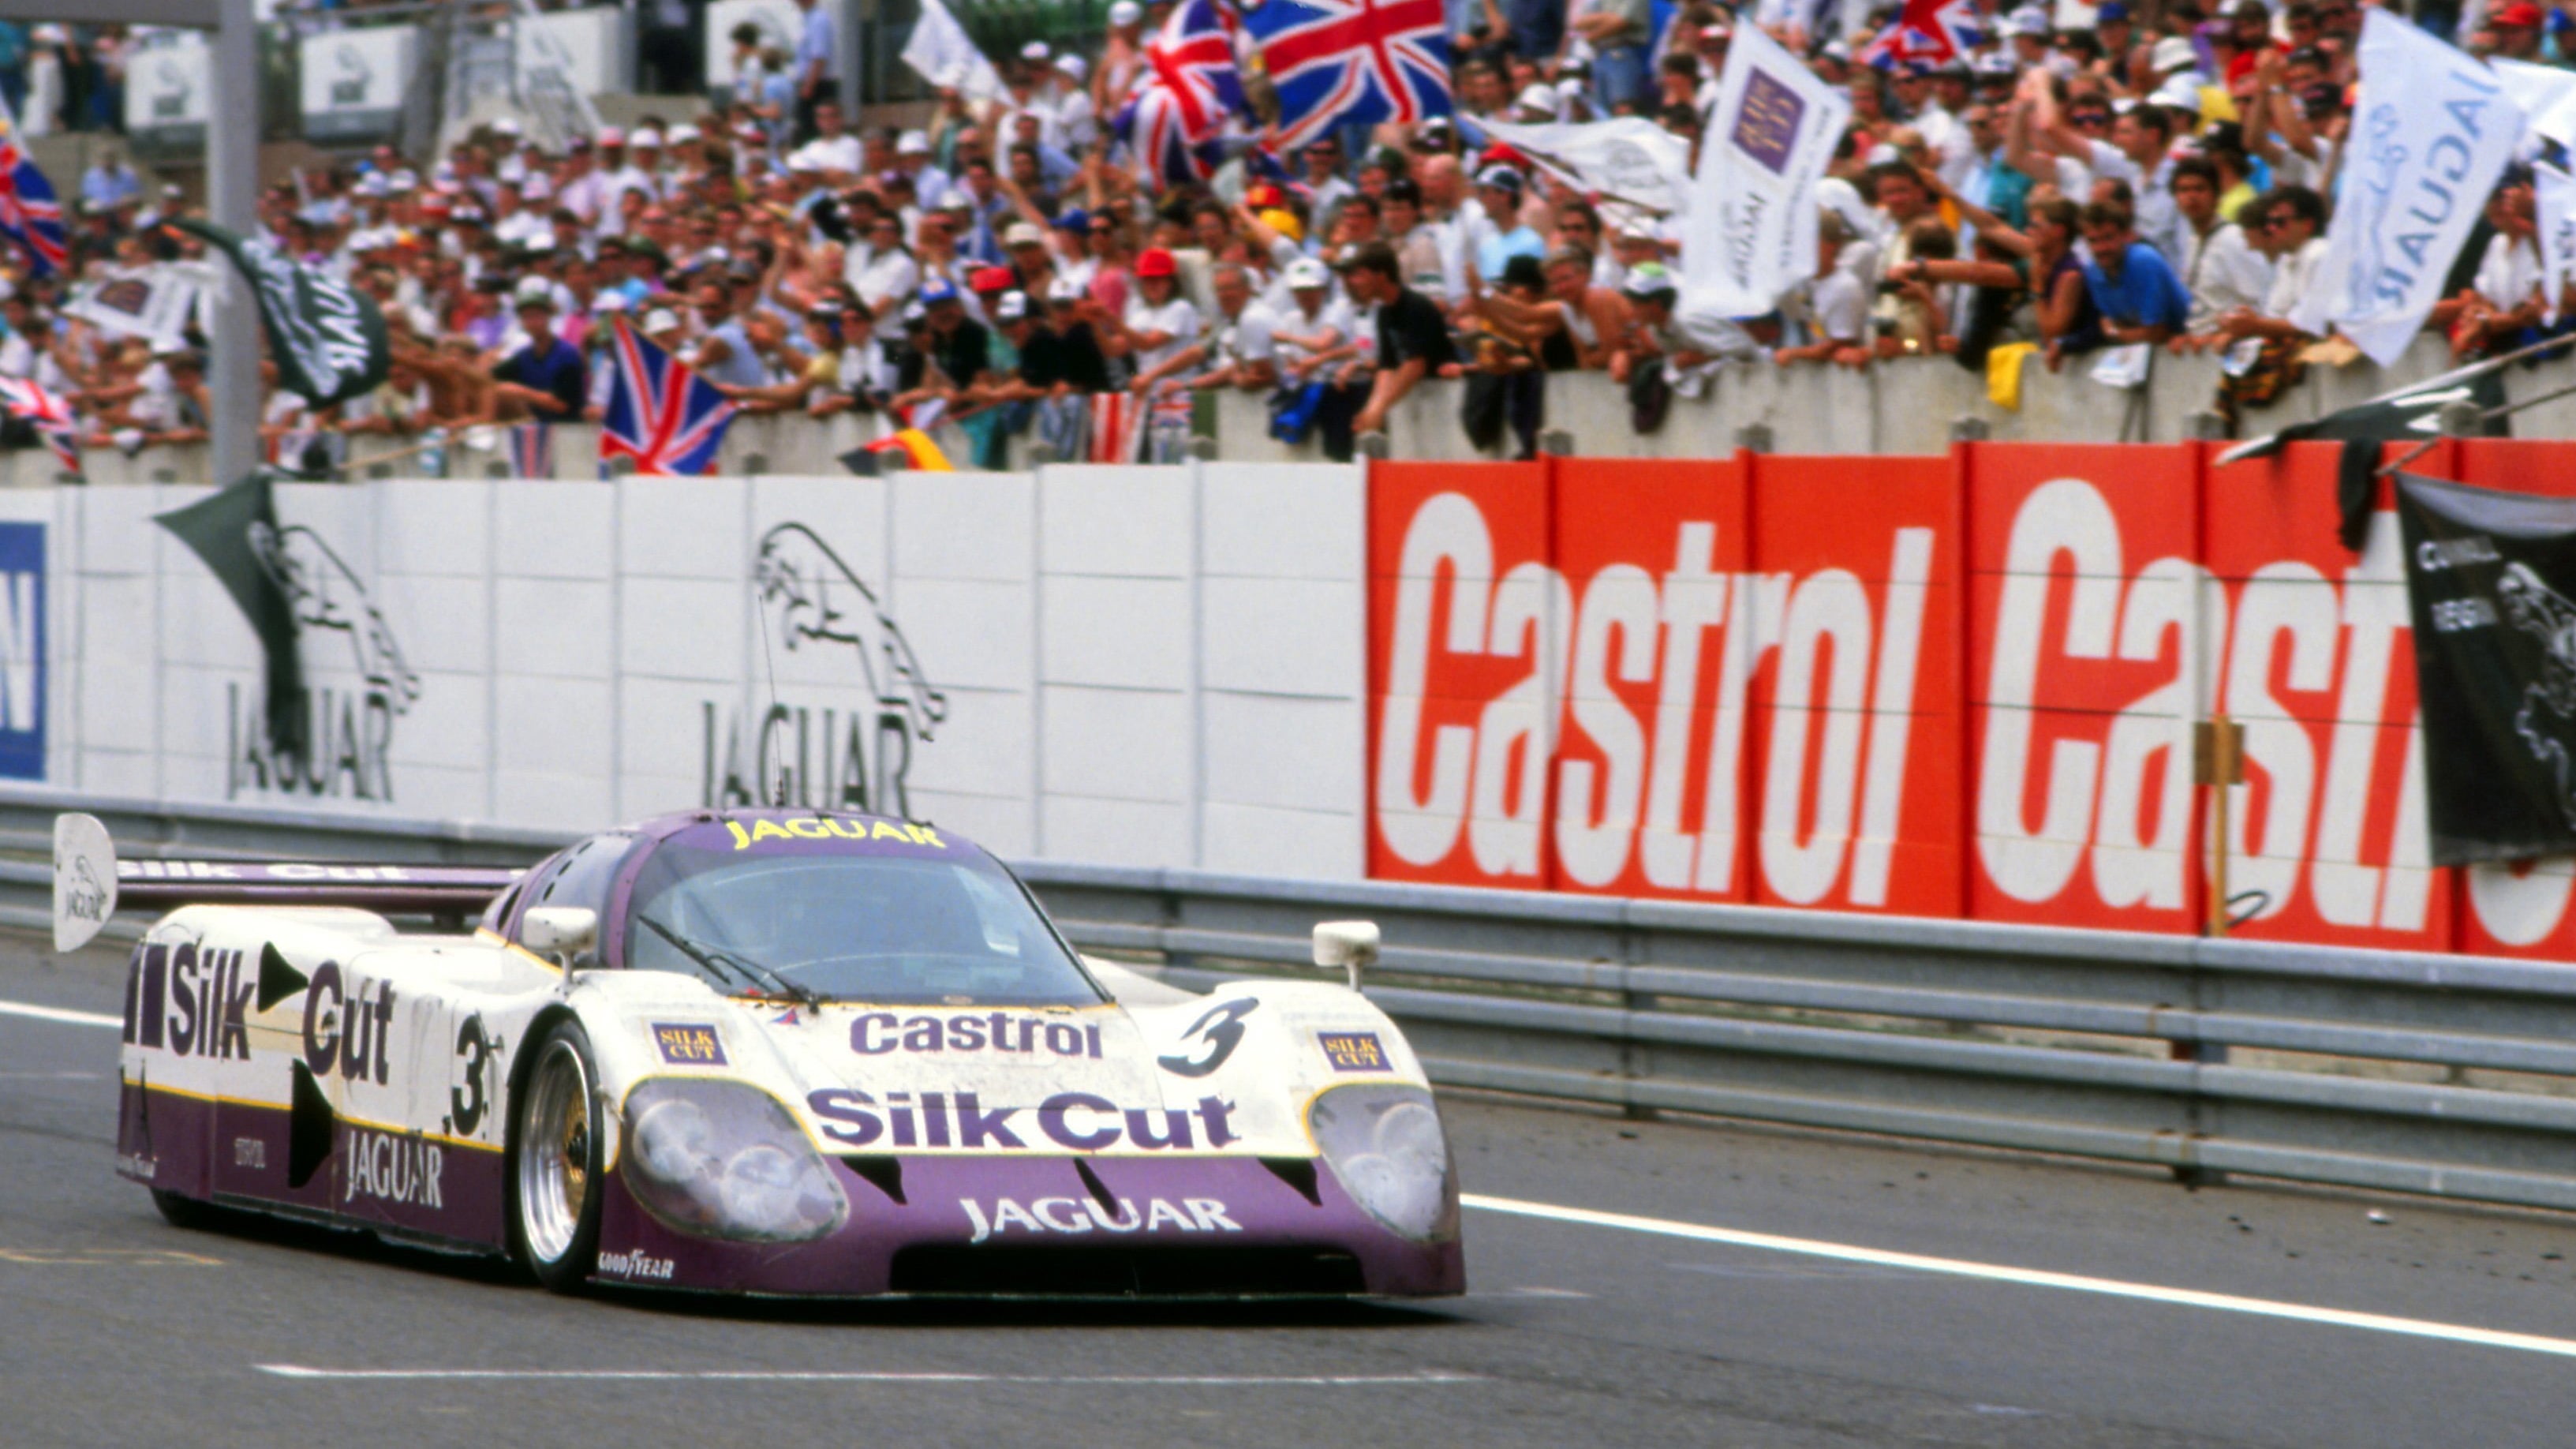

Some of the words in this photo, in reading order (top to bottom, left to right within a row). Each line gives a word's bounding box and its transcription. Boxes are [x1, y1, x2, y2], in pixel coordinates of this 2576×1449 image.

[1377, 491, 1935, 907] Castrol
[702, 699, 913, 819] JAGUAR
[725, 817, 947, 851] JAGUAR
[168, 942, 257, 1061] Silk
[303, 959, 395, 1086] Cut
[660, 1029, 715, 1046] SILK
[850, 1013, 1103, 1058] Castrol
[1157, 996, 1260, 1079] 3
[669, 1044, 714, 1060] CUT
[1326, 1037, 1378, 1054] SILK
[1337, 1051, 1379, 1066] CUT
[451, 1013, 488, 1136] 3
[806, 1088, 1028, 1149] Silk
[1038, 1091, 1243, 1150] Cut
[345, 1129, 443, 1209] JAGUAR
[959, 1198, 1243, 1244] JAGUAR
